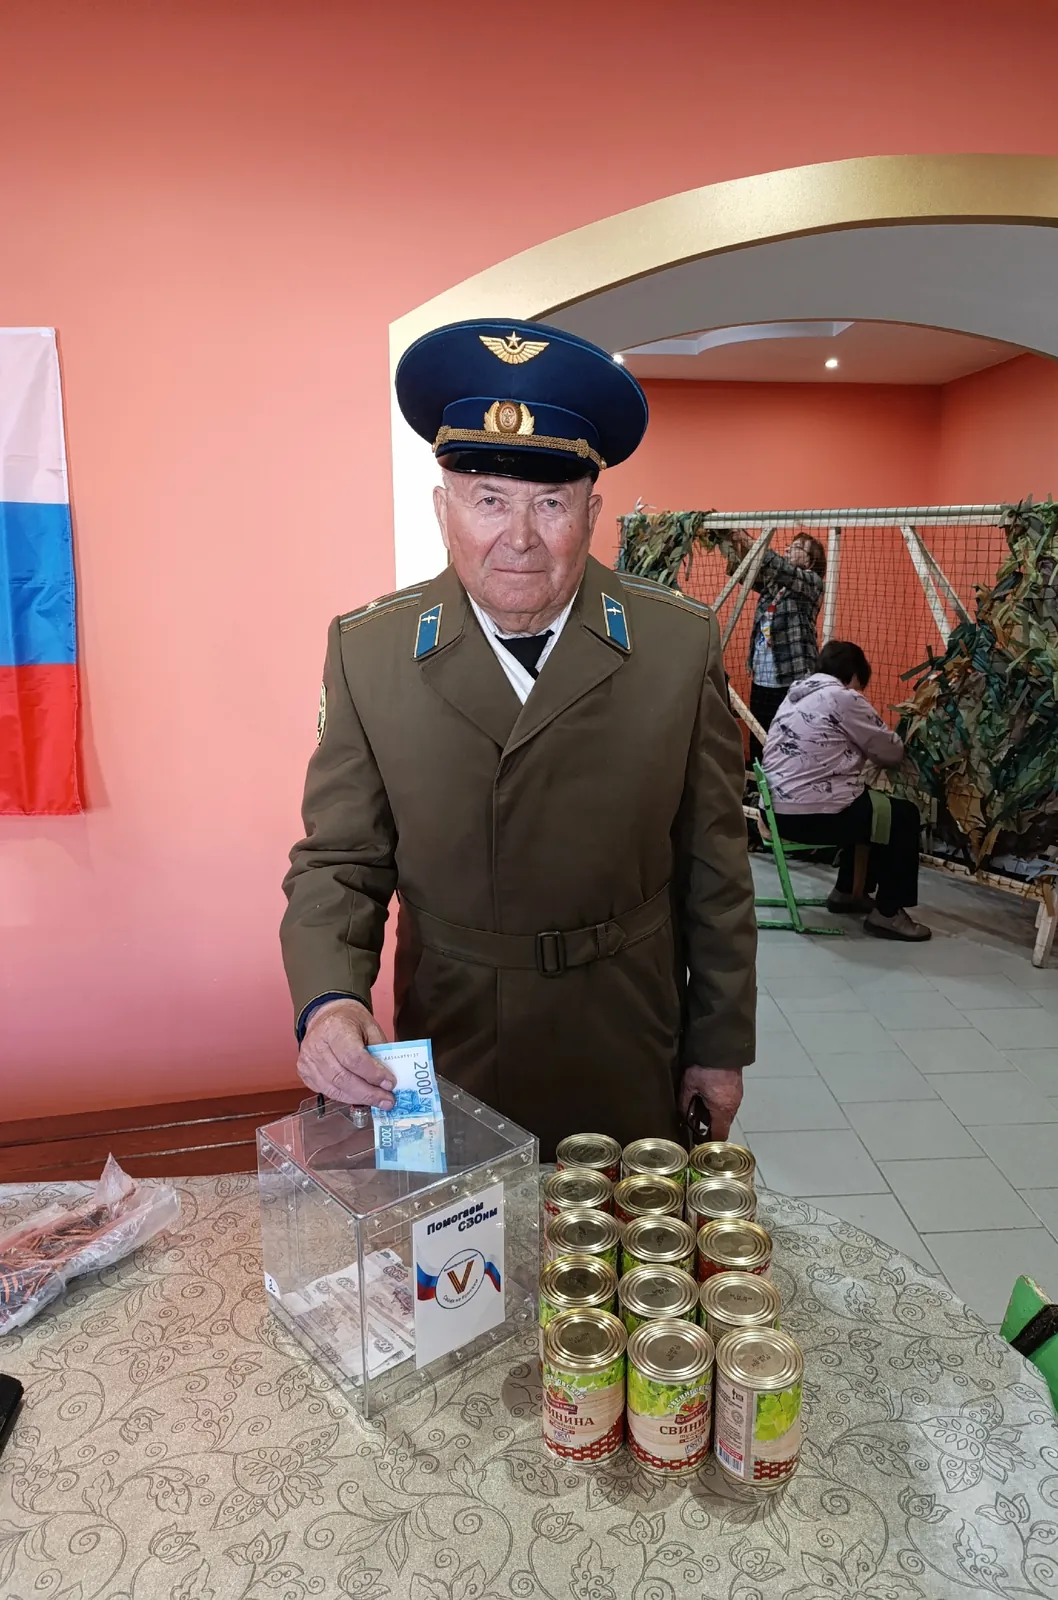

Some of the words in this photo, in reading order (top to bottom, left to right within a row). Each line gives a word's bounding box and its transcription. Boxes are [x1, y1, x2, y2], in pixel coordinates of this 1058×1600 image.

[413, 1061, 433, 1095] 2000
[381, 1128, 392, 1147] 2000
[427, 1202, 484, 1235] Помогаем
